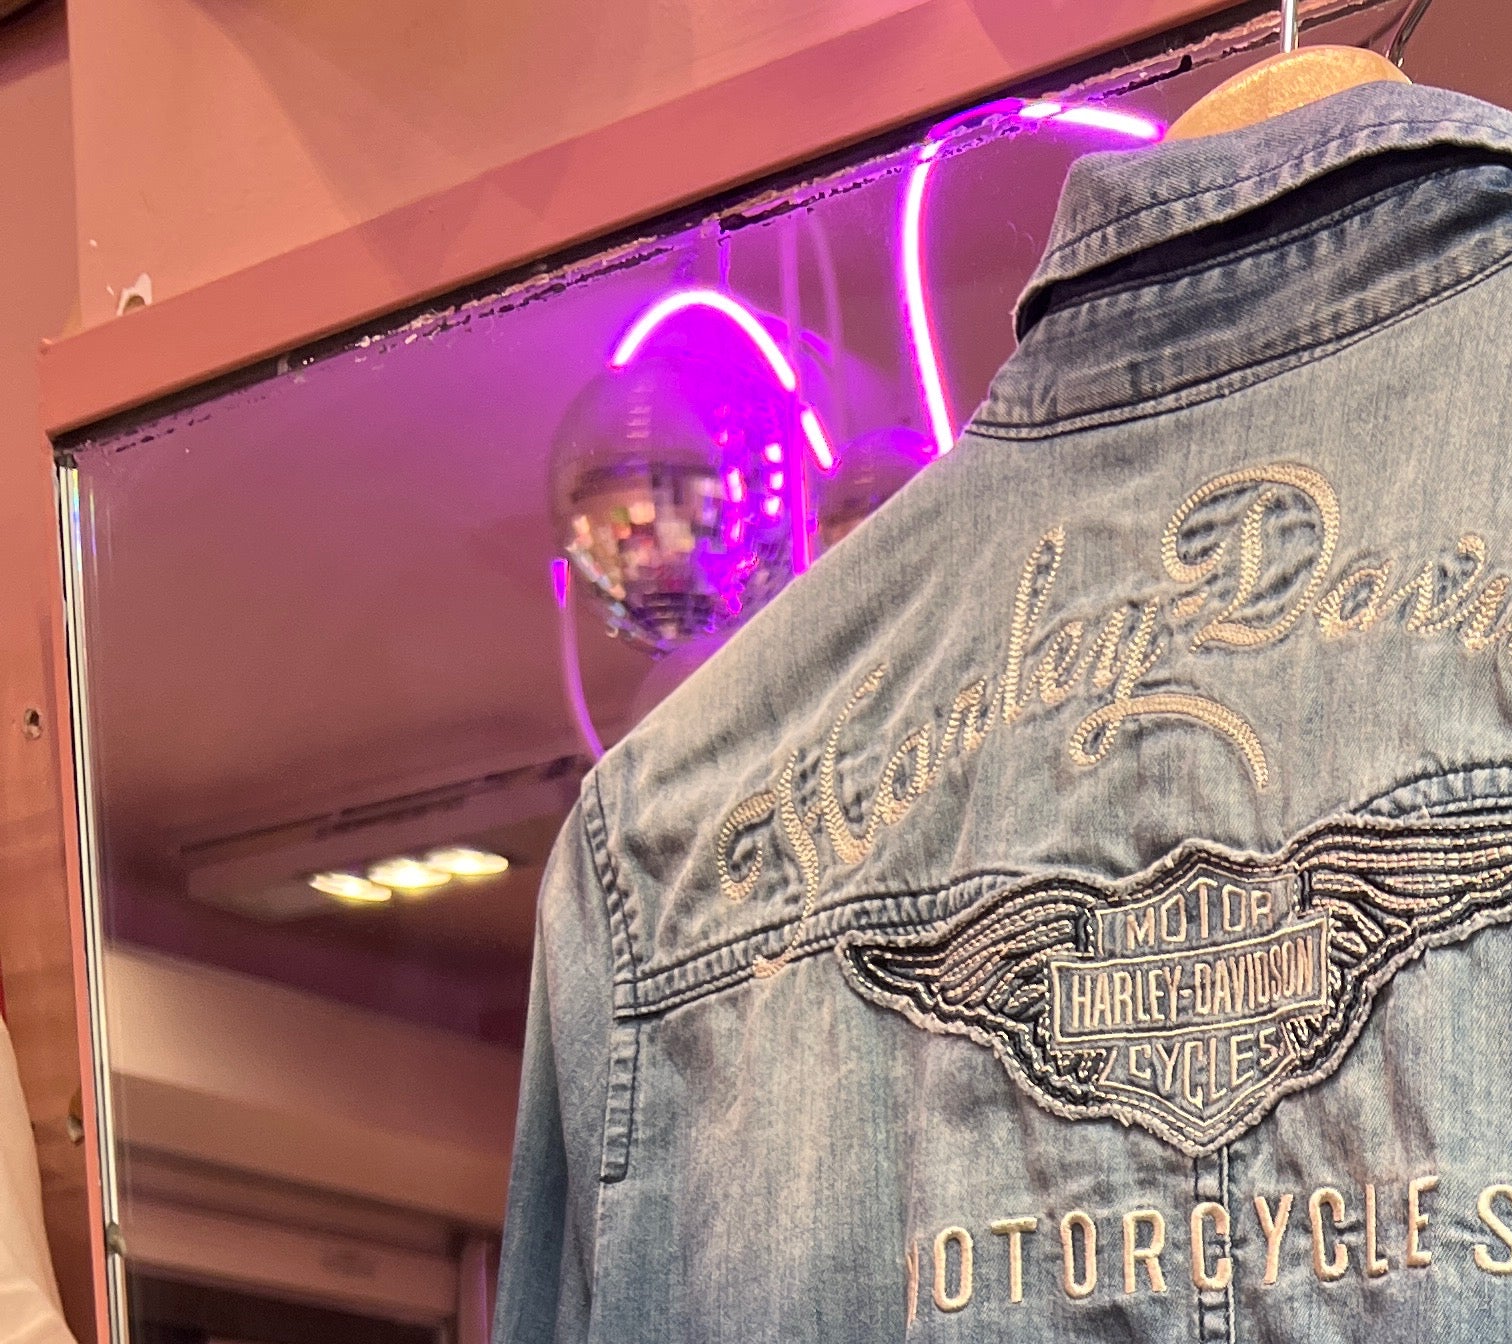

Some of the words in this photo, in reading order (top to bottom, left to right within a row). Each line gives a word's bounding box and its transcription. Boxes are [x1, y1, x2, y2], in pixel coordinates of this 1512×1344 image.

[1126, 877, 1273, 951] MOTOR
[1071, 935, 1314, 1029] HARLEY-DAVIDSON
[1128, 1026, 1280, 1109] CYCLES
